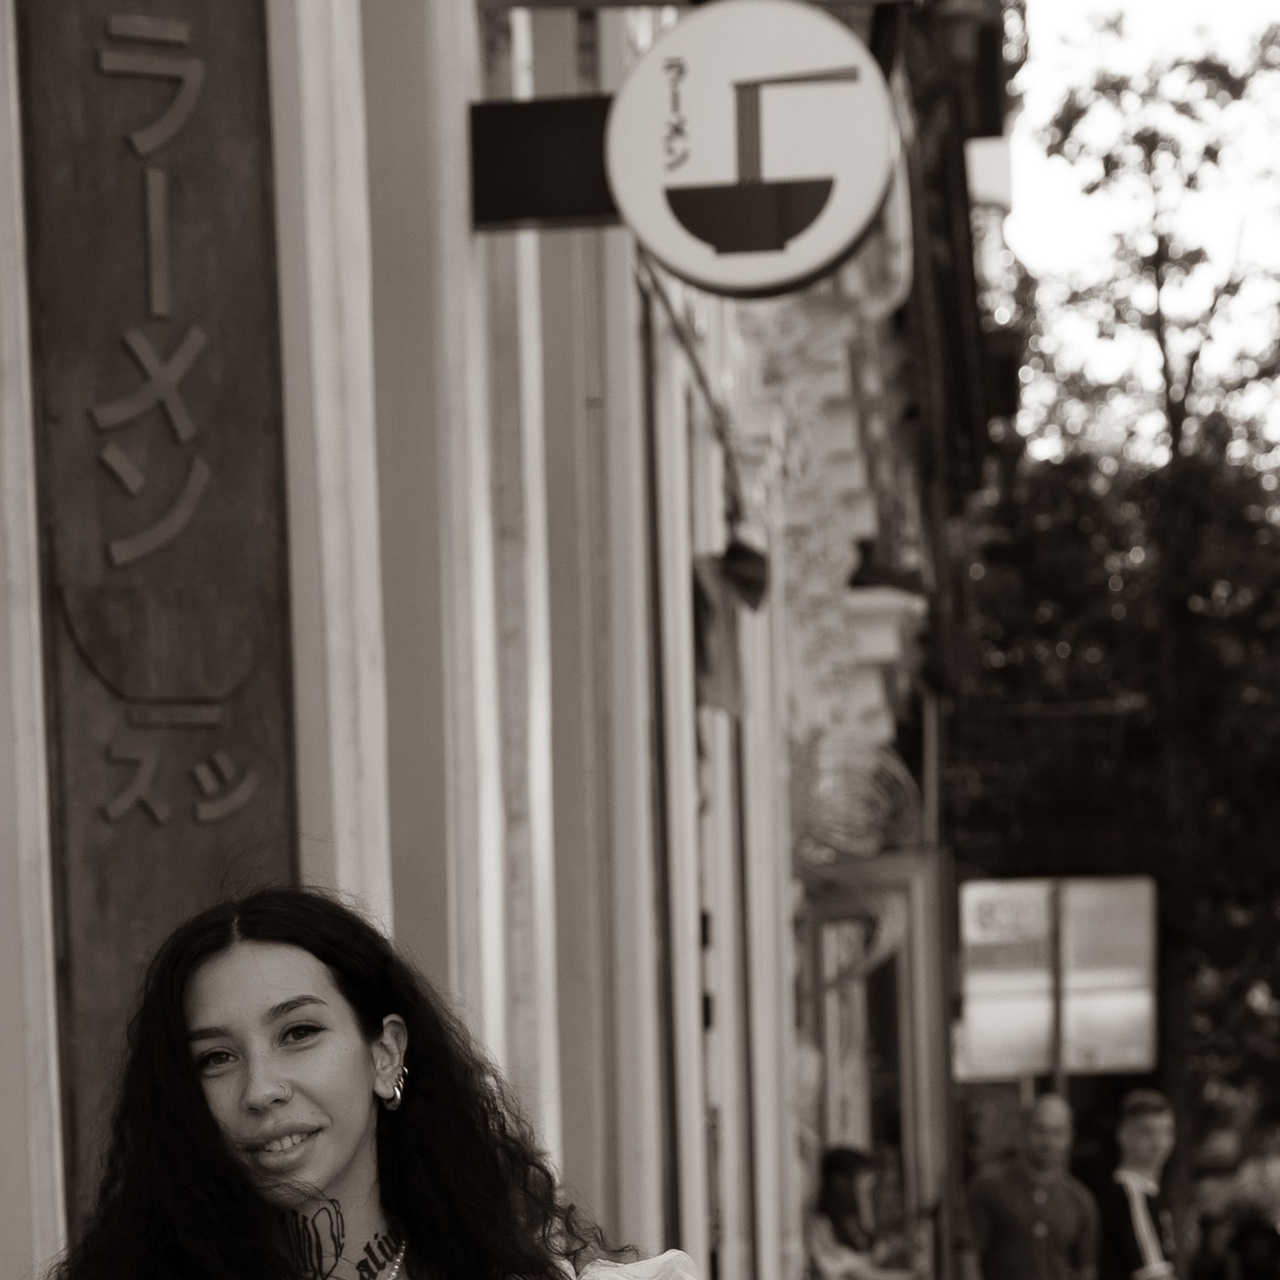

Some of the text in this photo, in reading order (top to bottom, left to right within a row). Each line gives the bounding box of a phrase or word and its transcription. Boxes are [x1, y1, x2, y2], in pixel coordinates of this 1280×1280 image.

[661, 56, 691, 173] ラーメン
[87, 12, 212, 568] ラーメン
